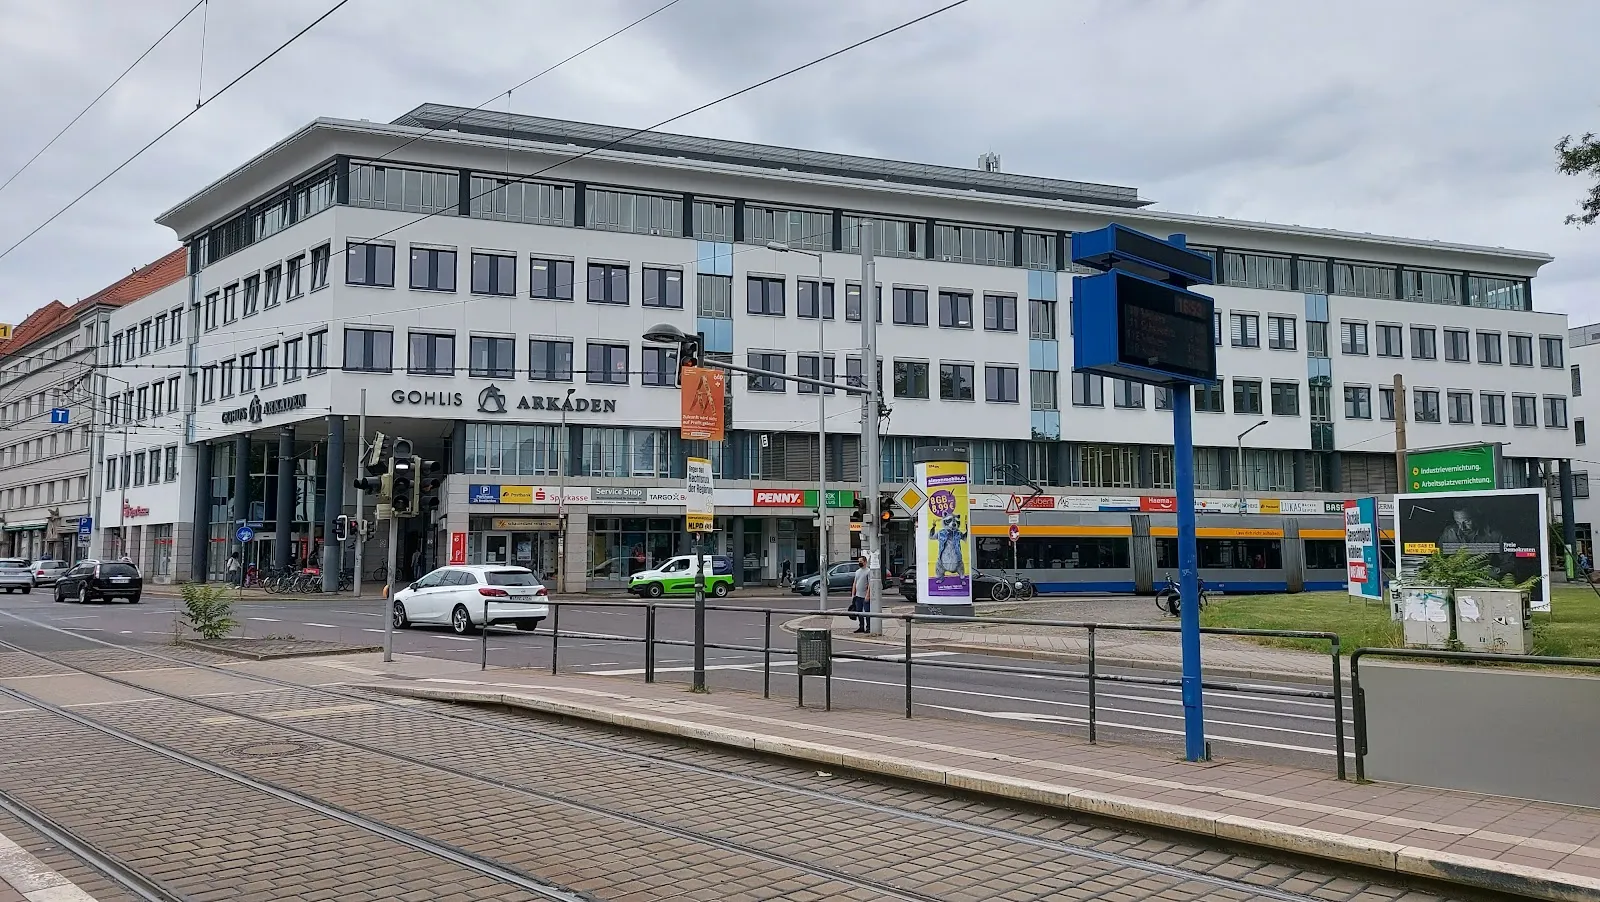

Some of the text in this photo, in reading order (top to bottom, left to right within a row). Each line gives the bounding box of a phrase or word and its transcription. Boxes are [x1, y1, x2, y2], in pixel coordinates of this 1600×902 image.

[263, 394, 307, 416] ARKADEN
[391, 389, 463, 406] GOHLIS
[516, 395, 617, 413] ARKADEN
[56, 410, 66, 422] T
[1421, 464, 1481, 475] Industrievernichtung.
[1421, 477, 1492, 488] Arbeitsplatzvernichtung.
[596, 488, 642, 497] Service Shop
[550, 494, 588, 503] Sprkasse
